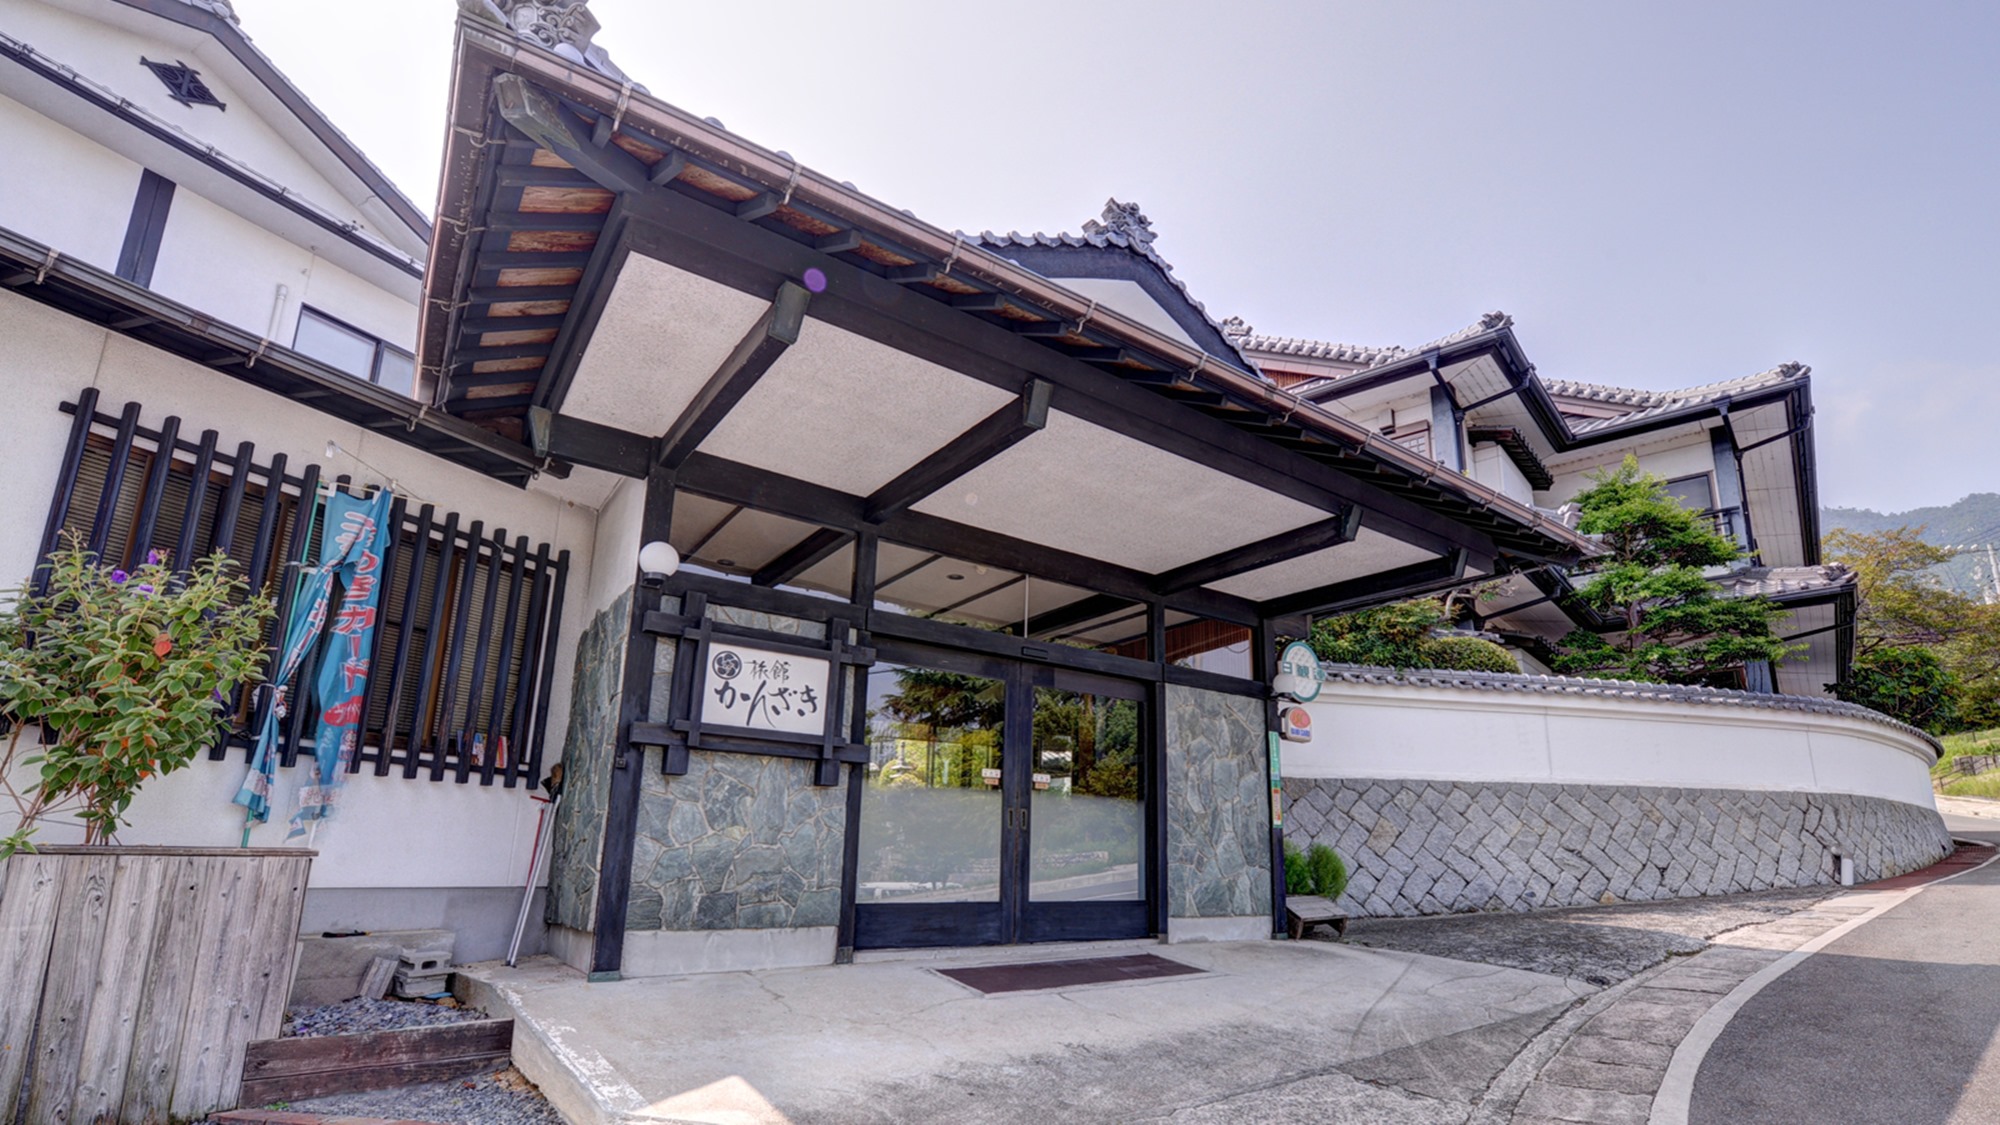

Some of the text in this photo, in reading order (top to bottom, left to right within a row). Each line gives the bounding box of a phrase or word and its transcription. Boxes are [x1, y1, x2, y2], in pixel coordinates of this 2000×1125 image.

[744, 659, 792, 684] 旅館
[714, 680, 818, 728] かんざき
